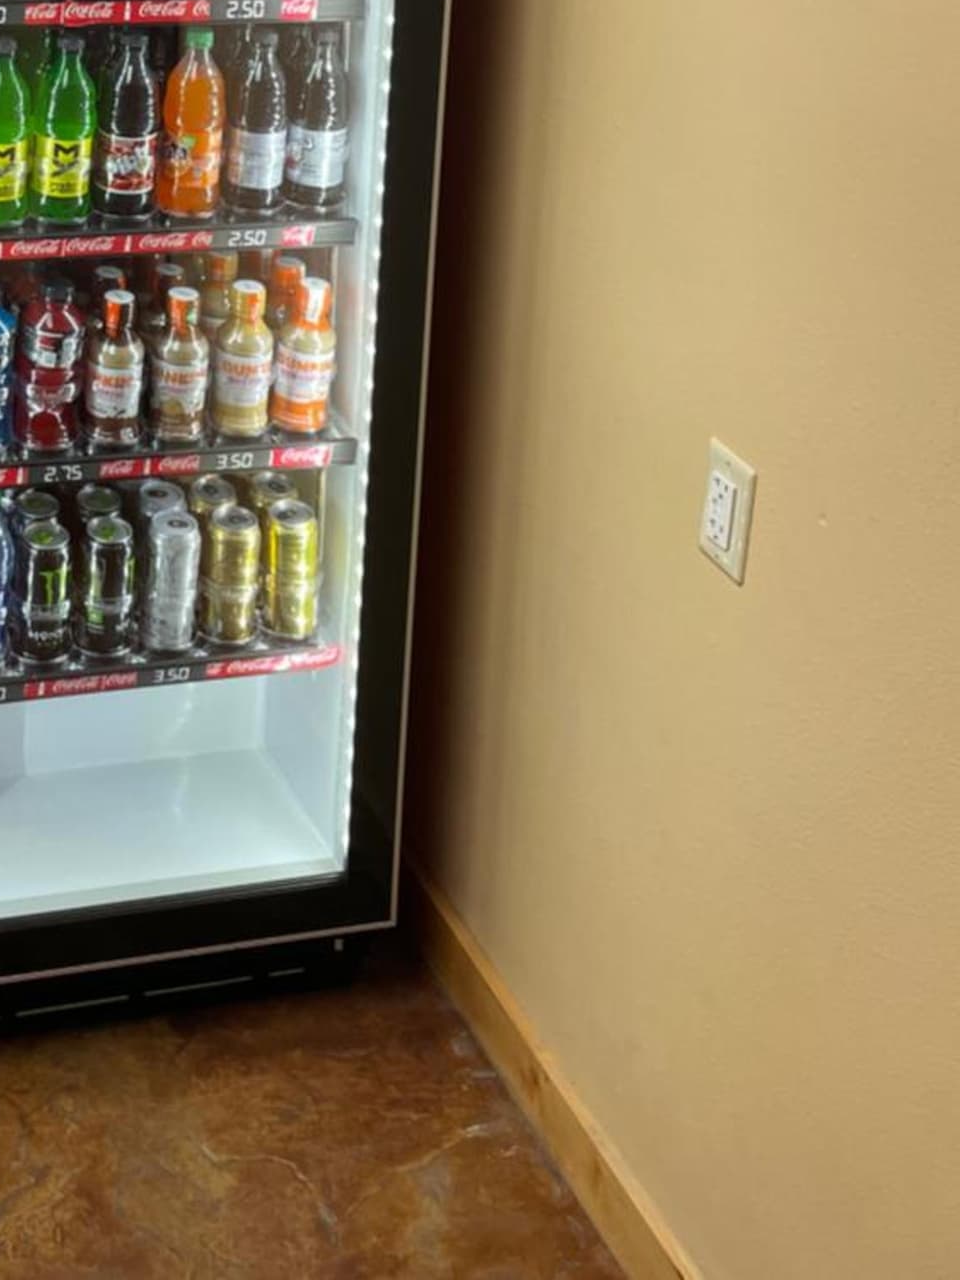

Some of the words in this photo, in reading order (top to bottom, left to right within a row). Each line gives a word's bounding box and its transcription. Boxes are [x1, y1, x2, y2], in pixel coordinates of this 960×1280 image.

[227, 0, 265, 18] 2.50
[228, 230, 267, 247] 2.50
[216, 453, 255, 470] 3.50
[44, 465, 83, 482] 2.75
[152, 667, 189, 683] 3.50
